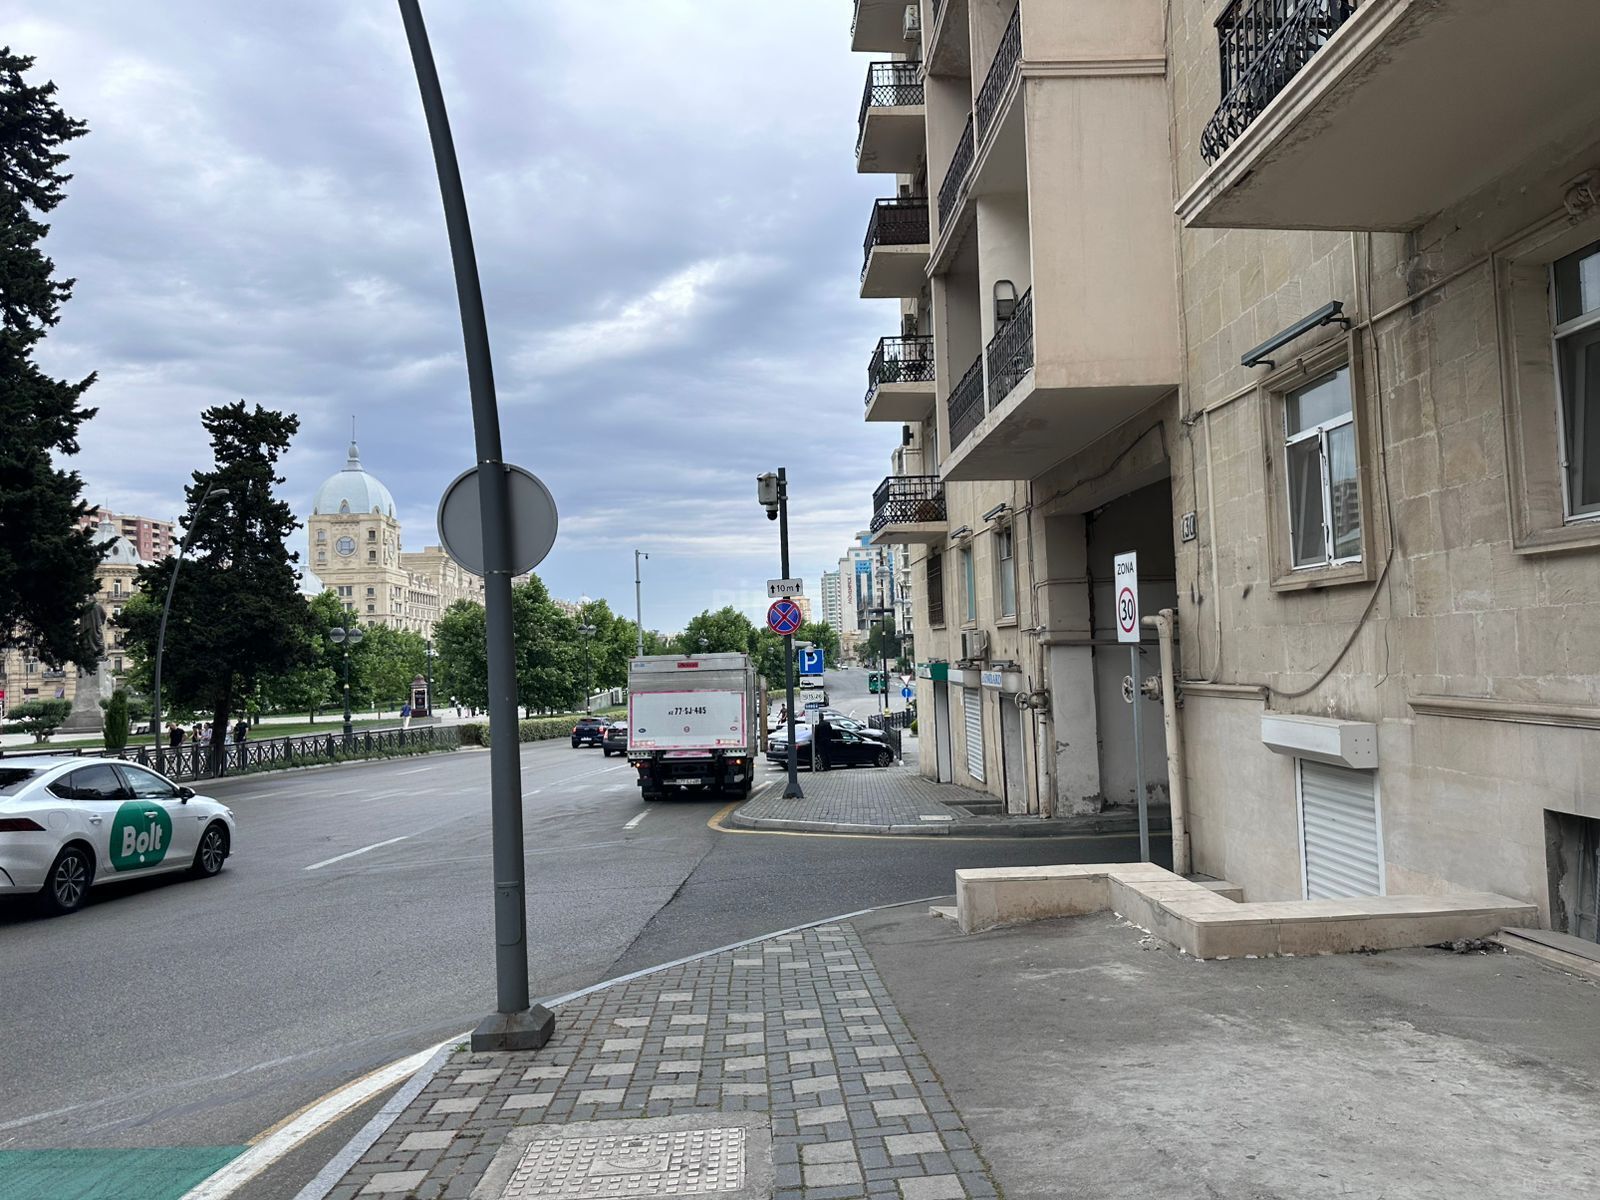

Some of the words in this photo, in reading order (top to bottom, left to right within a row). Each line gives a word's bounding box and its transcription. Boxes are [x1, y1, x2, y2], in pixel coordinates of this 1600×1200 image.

[1117, 561, 1134, 576] ZONA
[1120, 598, 1134, 621] 30
[804, 650, 818, 671] P
[121, 821, 163, 857] Bolt
